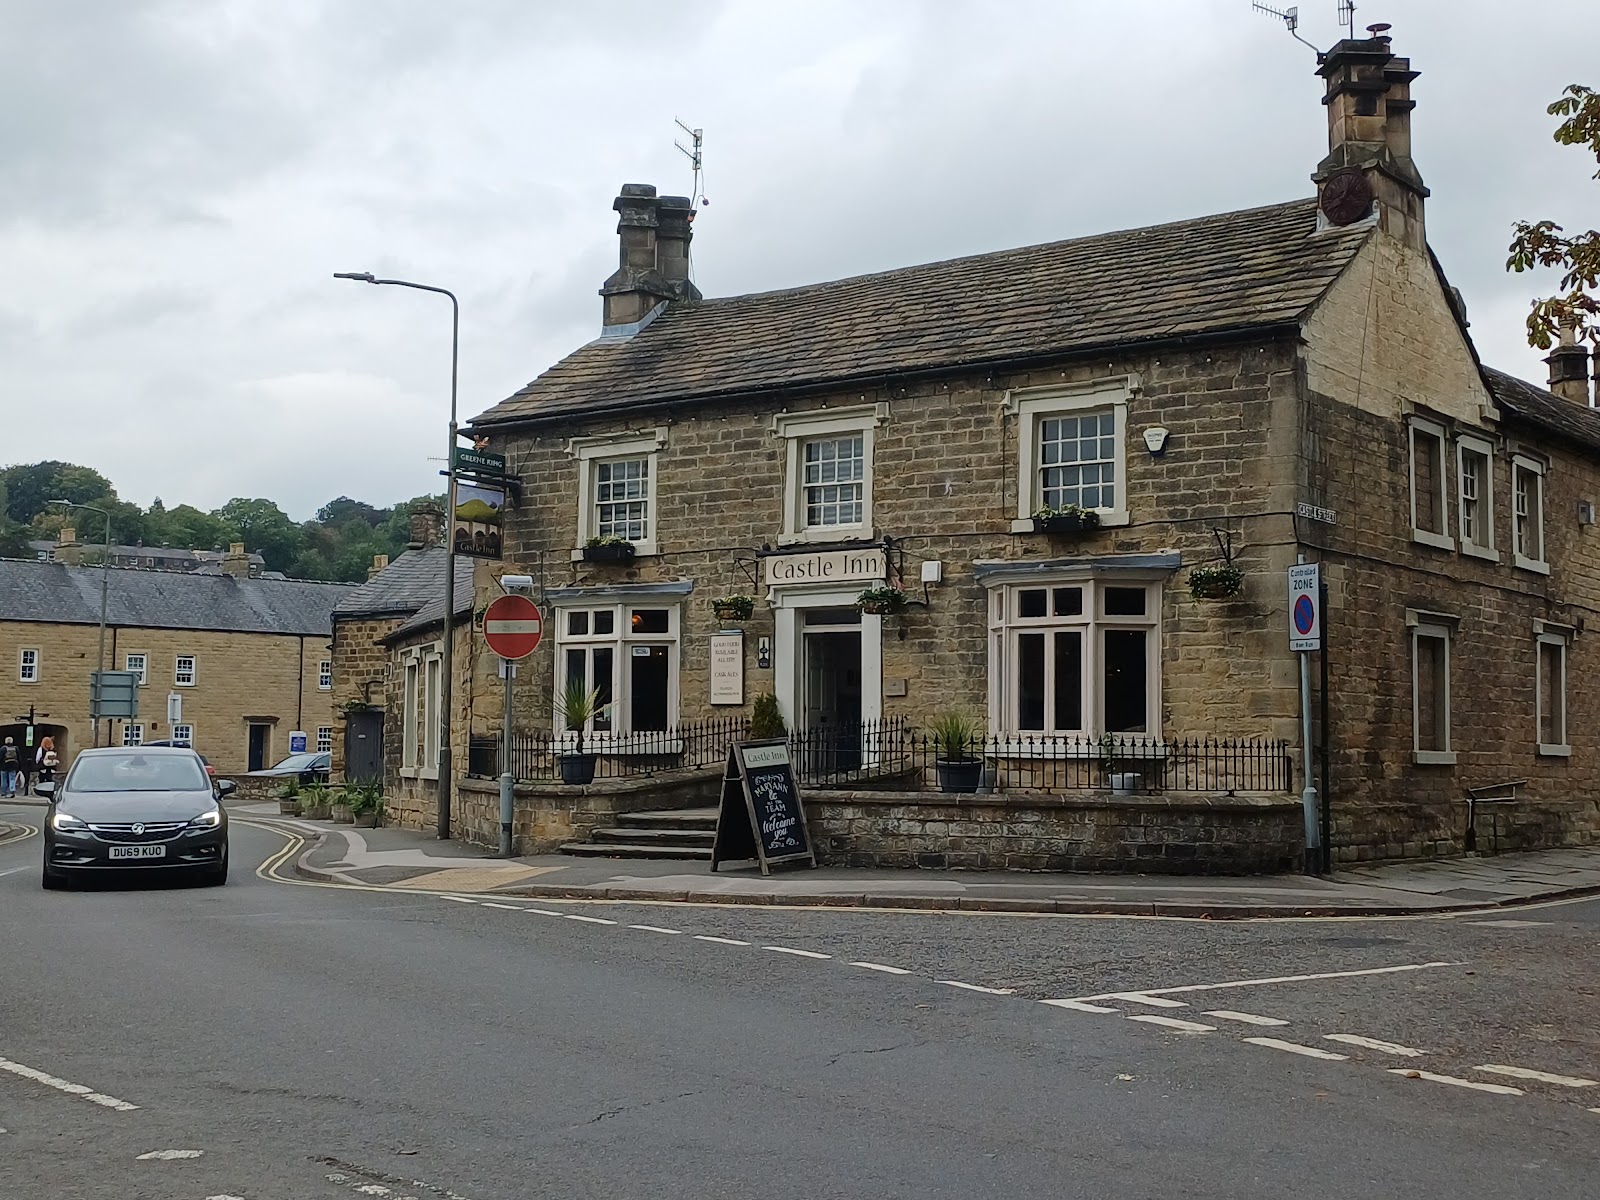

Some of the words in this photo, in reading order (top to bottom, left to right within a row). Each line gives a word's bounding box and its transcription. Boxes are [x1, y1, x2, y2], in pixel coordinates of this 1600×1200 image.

[460, 453, 486, 465] GREENE
[486, 459, 503, 468] KING
[1299, 504, 1317, 518] CASTLE
[1318, 508, 1335, 522] STREET
[460, 542, 482, 552] Castle
[482, 545, 495, 555] Inn
[772, 556, 833, 579] Castle
[843, 555, 878, 575] Inn
[1293, 578, 1314, 590] ZONE
[747, 751, 770, 762] Castle
[771, 751, 785, 760] Inn
[765, 804, 786, 813] TEAM
[113, 847, 140, 857] DU69
